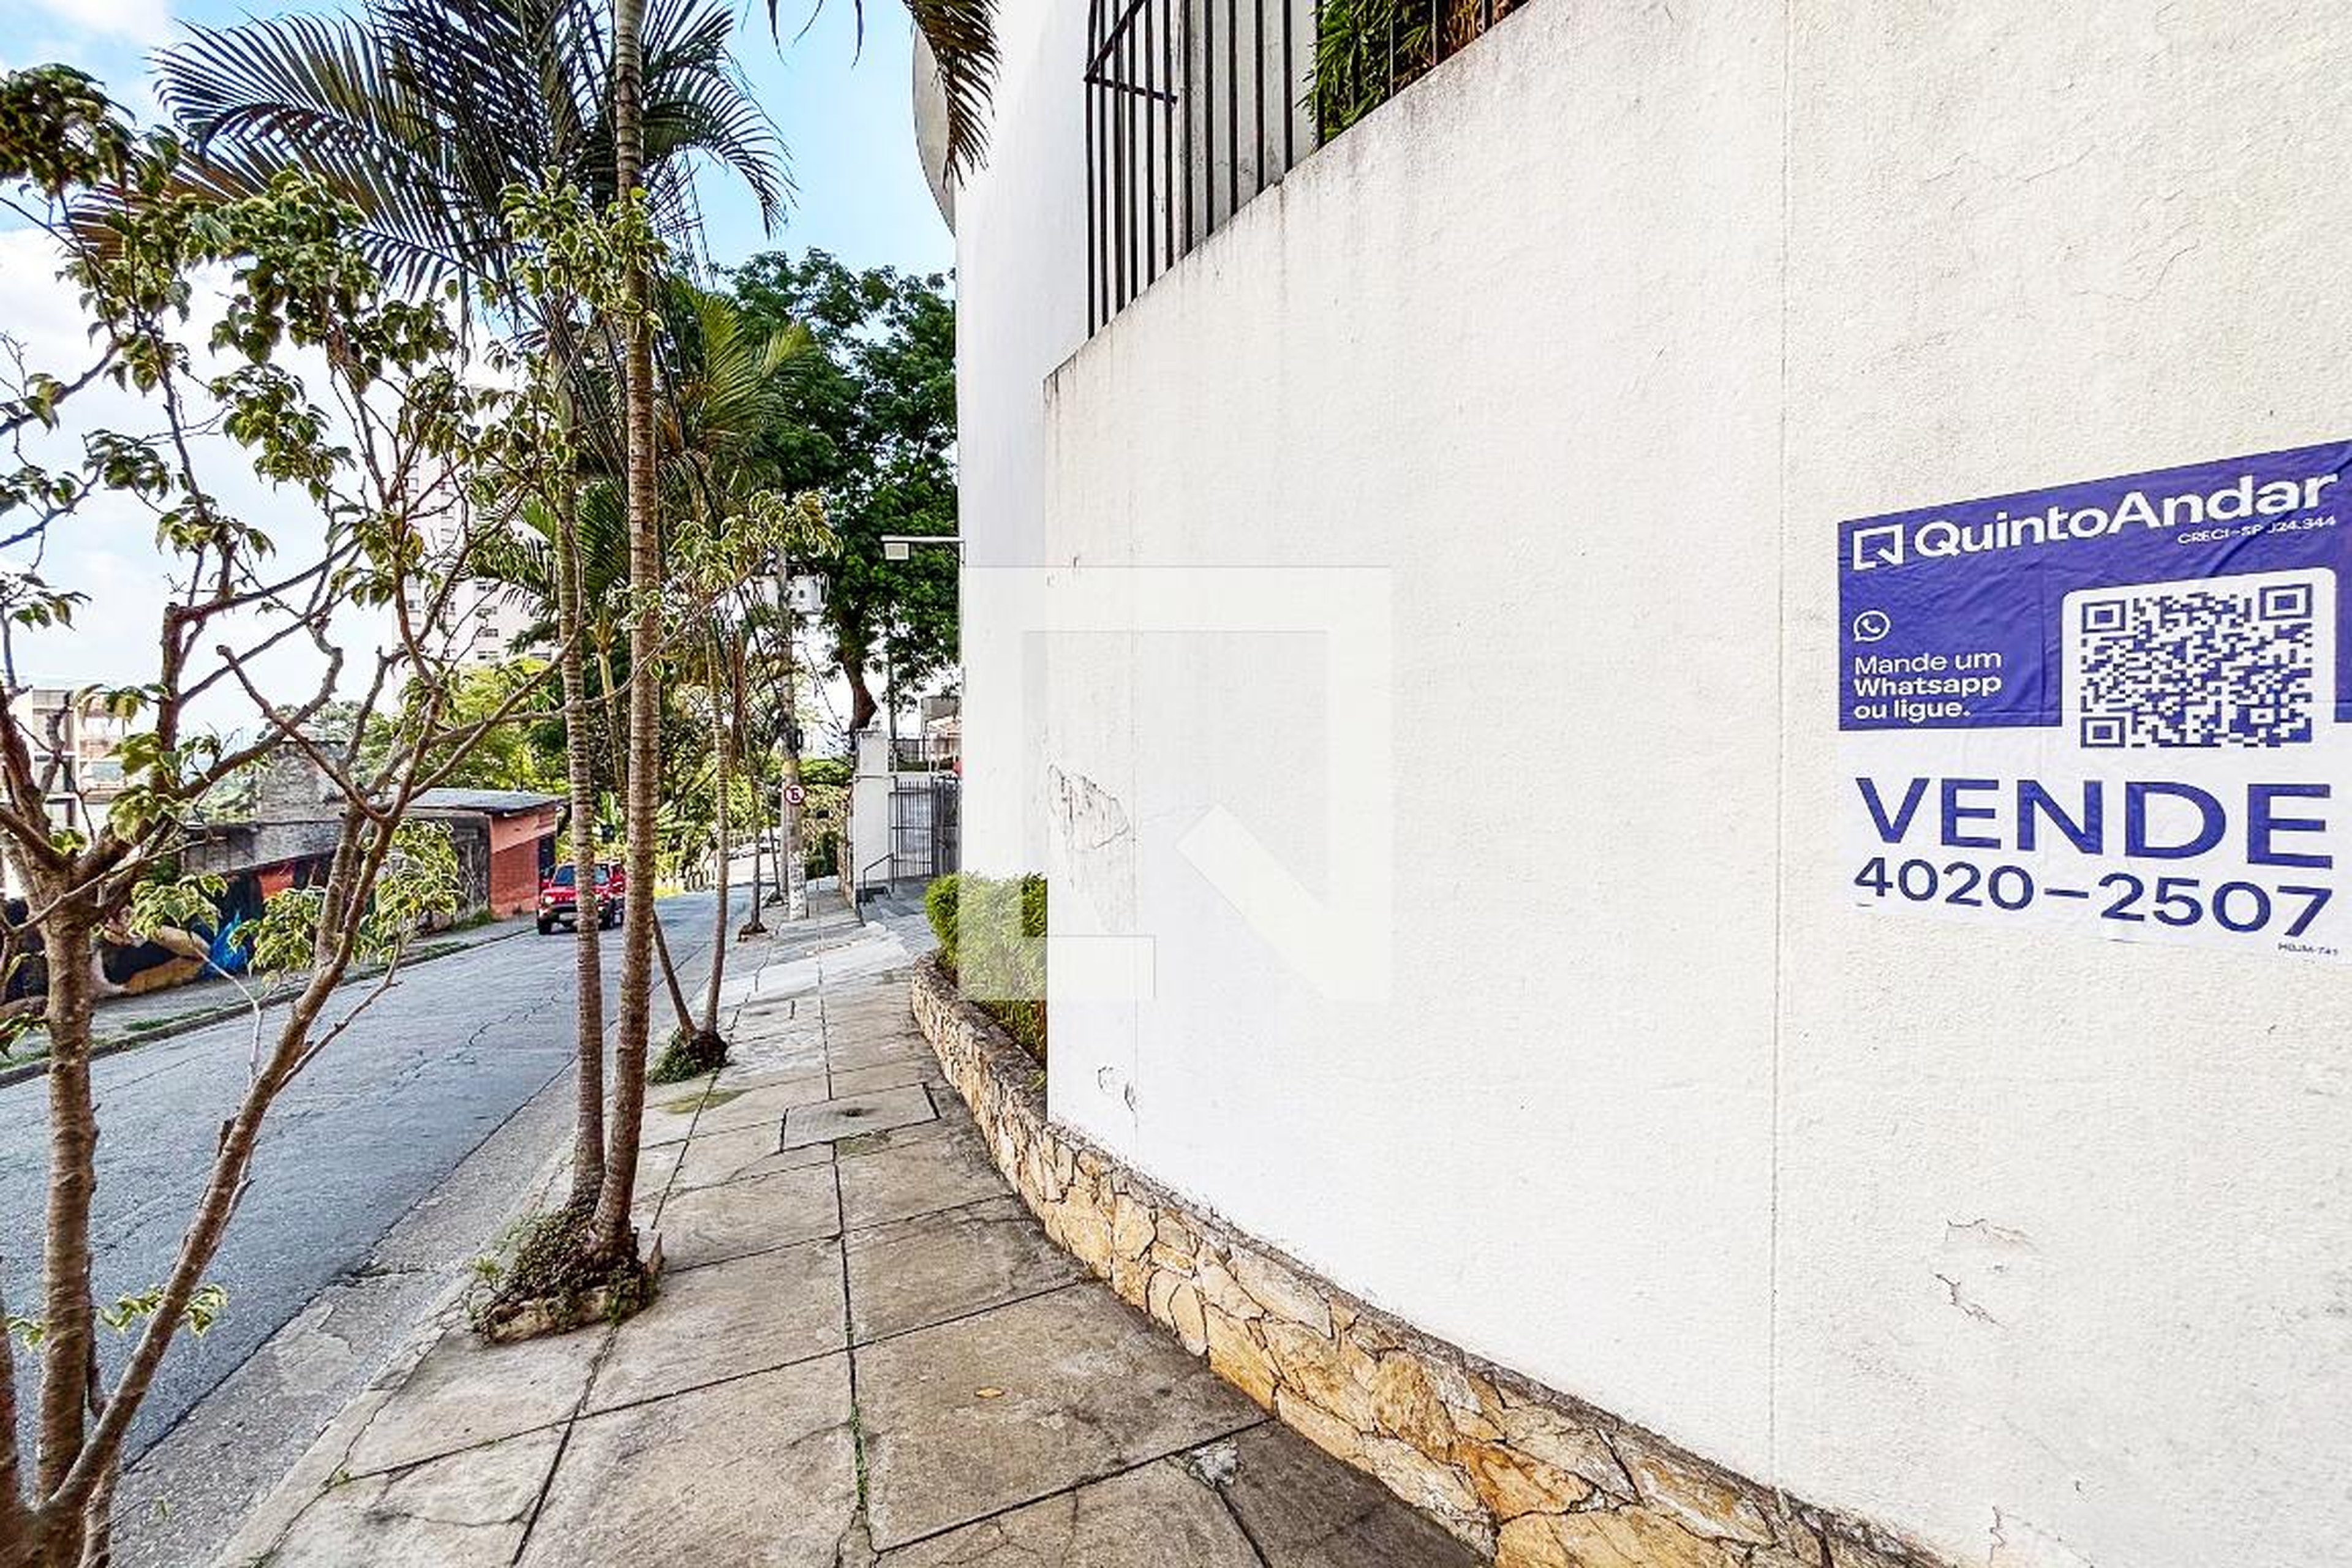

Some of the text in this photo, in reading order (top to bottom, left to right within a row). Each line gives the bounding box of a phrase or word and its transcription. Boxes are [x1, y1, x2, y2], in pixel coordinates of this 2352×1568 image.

[1914, 474, 2339, 557] QuintoAndar
[1853, 676, 2002, 698] Whatsapp
[1855, 652, 2002, 674] Mande um
[1854, 699, 1971, 722] ou ligue.
[1855, 777, 2332, 869] VENDE
[1853, 857, 2332, 938] 4020-2507
